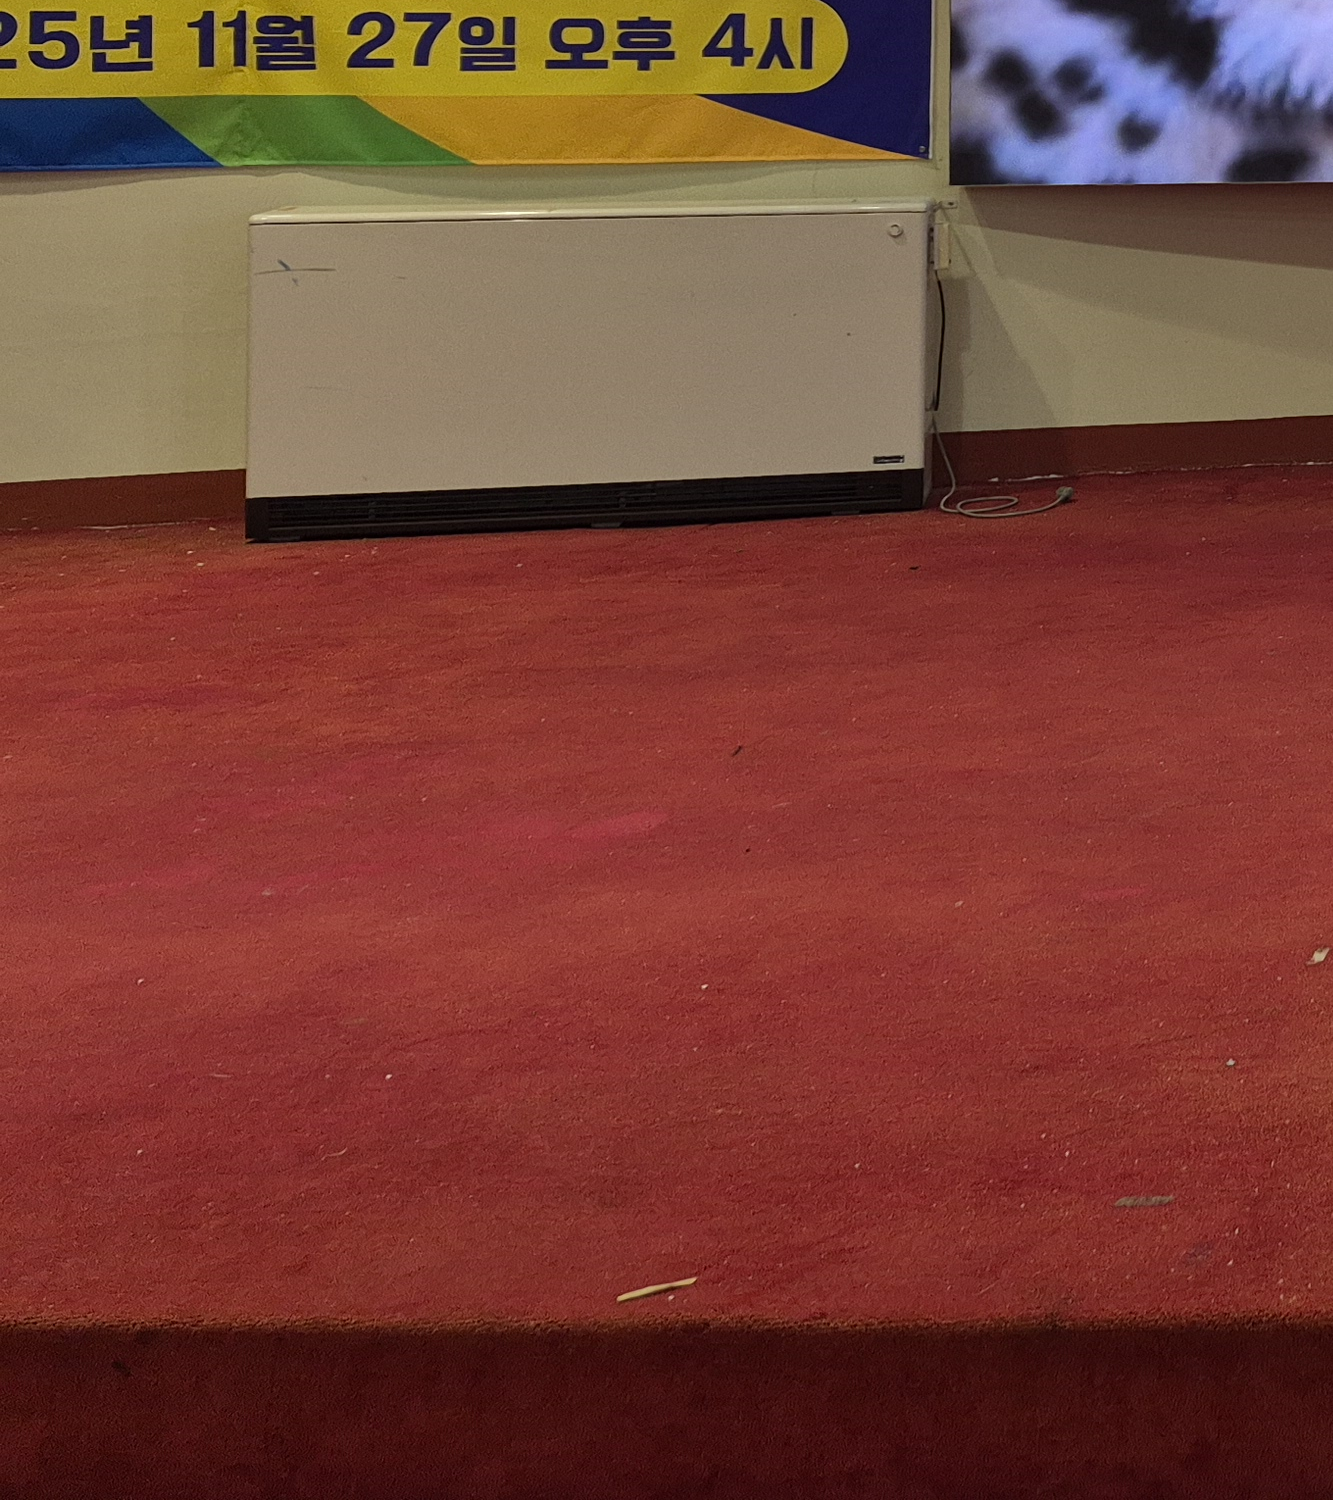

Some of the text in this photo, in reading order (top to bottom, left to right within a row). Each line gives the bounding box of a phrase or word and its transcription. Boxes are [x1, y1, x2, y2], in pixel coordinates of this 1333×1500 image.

[187, 10, 317, 73] 11월
[346, 12, 518, 73] 27일
[544, 15, 676, 73] 오후
[702, 12, 815, 72] 4시
